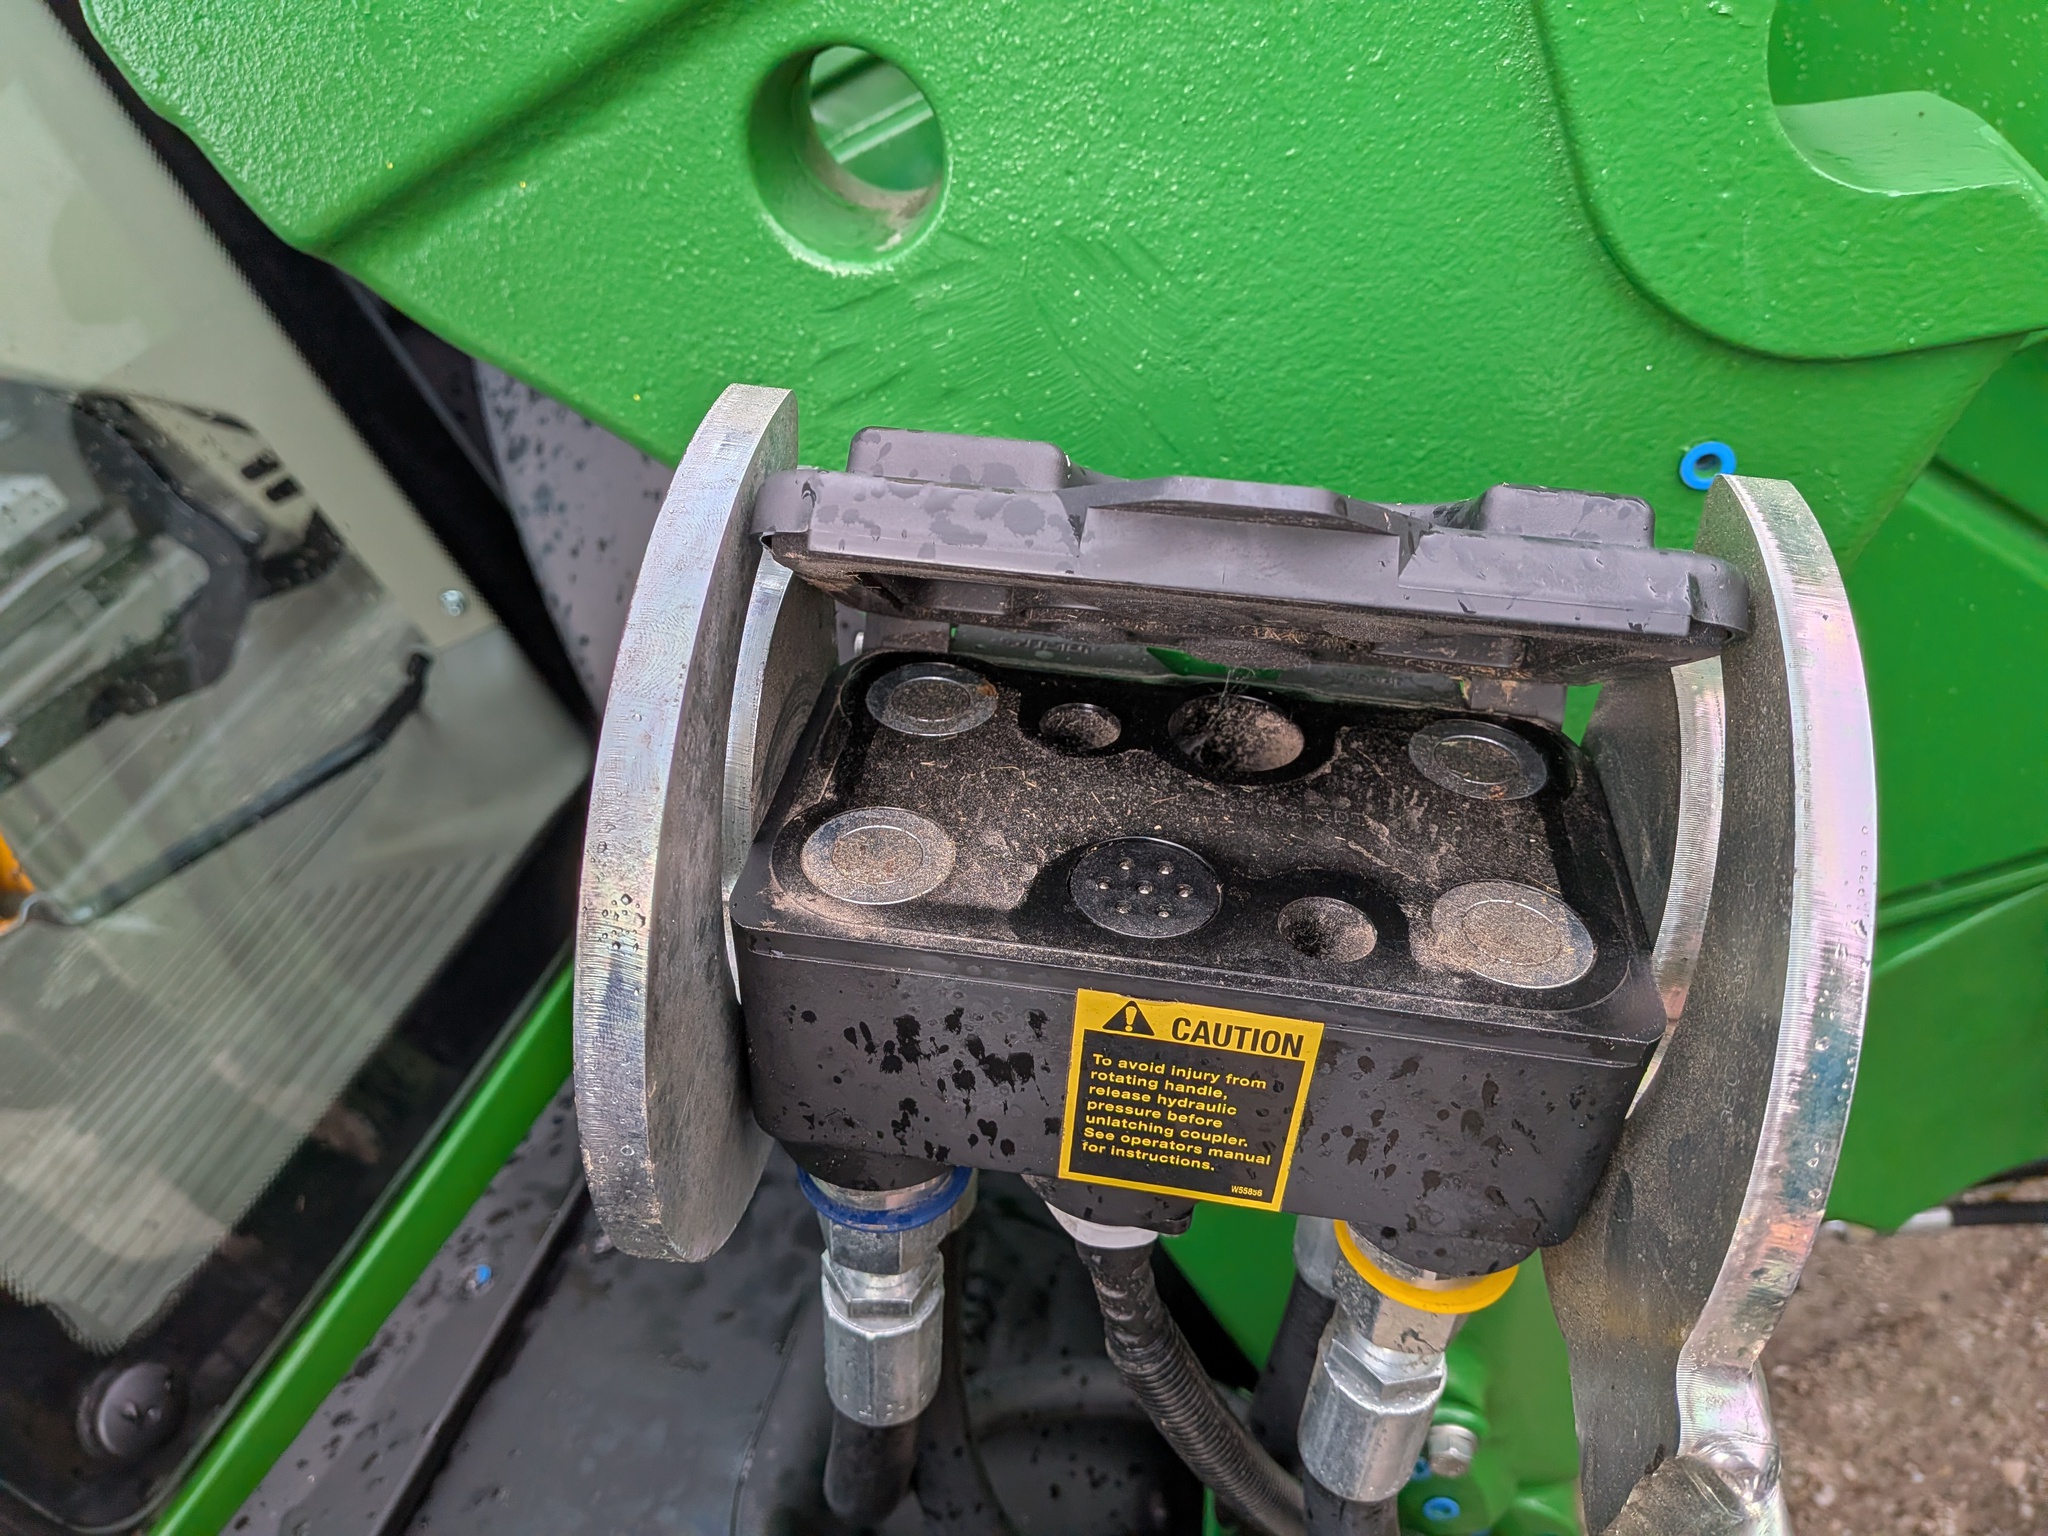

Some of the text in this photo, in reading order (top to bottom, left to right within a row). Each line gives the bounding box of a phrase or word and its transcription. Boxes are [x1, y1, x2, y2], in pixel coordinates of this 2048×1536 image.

[1171, 1017, 1304, 1058] CAUTION
[1090, 1070, 1228, 1100] rotating handle,
[1092, 1053, 1267, 1089] To avoid injury from
[1086, 1100, 1223, 1128] pressure before
[1089, 1085, 1238, 1116] release hydraulic
[1083, 1127, 1271, 1165] See operators manual
[1085, 1114, 1248, 1147] unlatching coupler.
[1082, 1141, 1215, 1171] for instructions.
